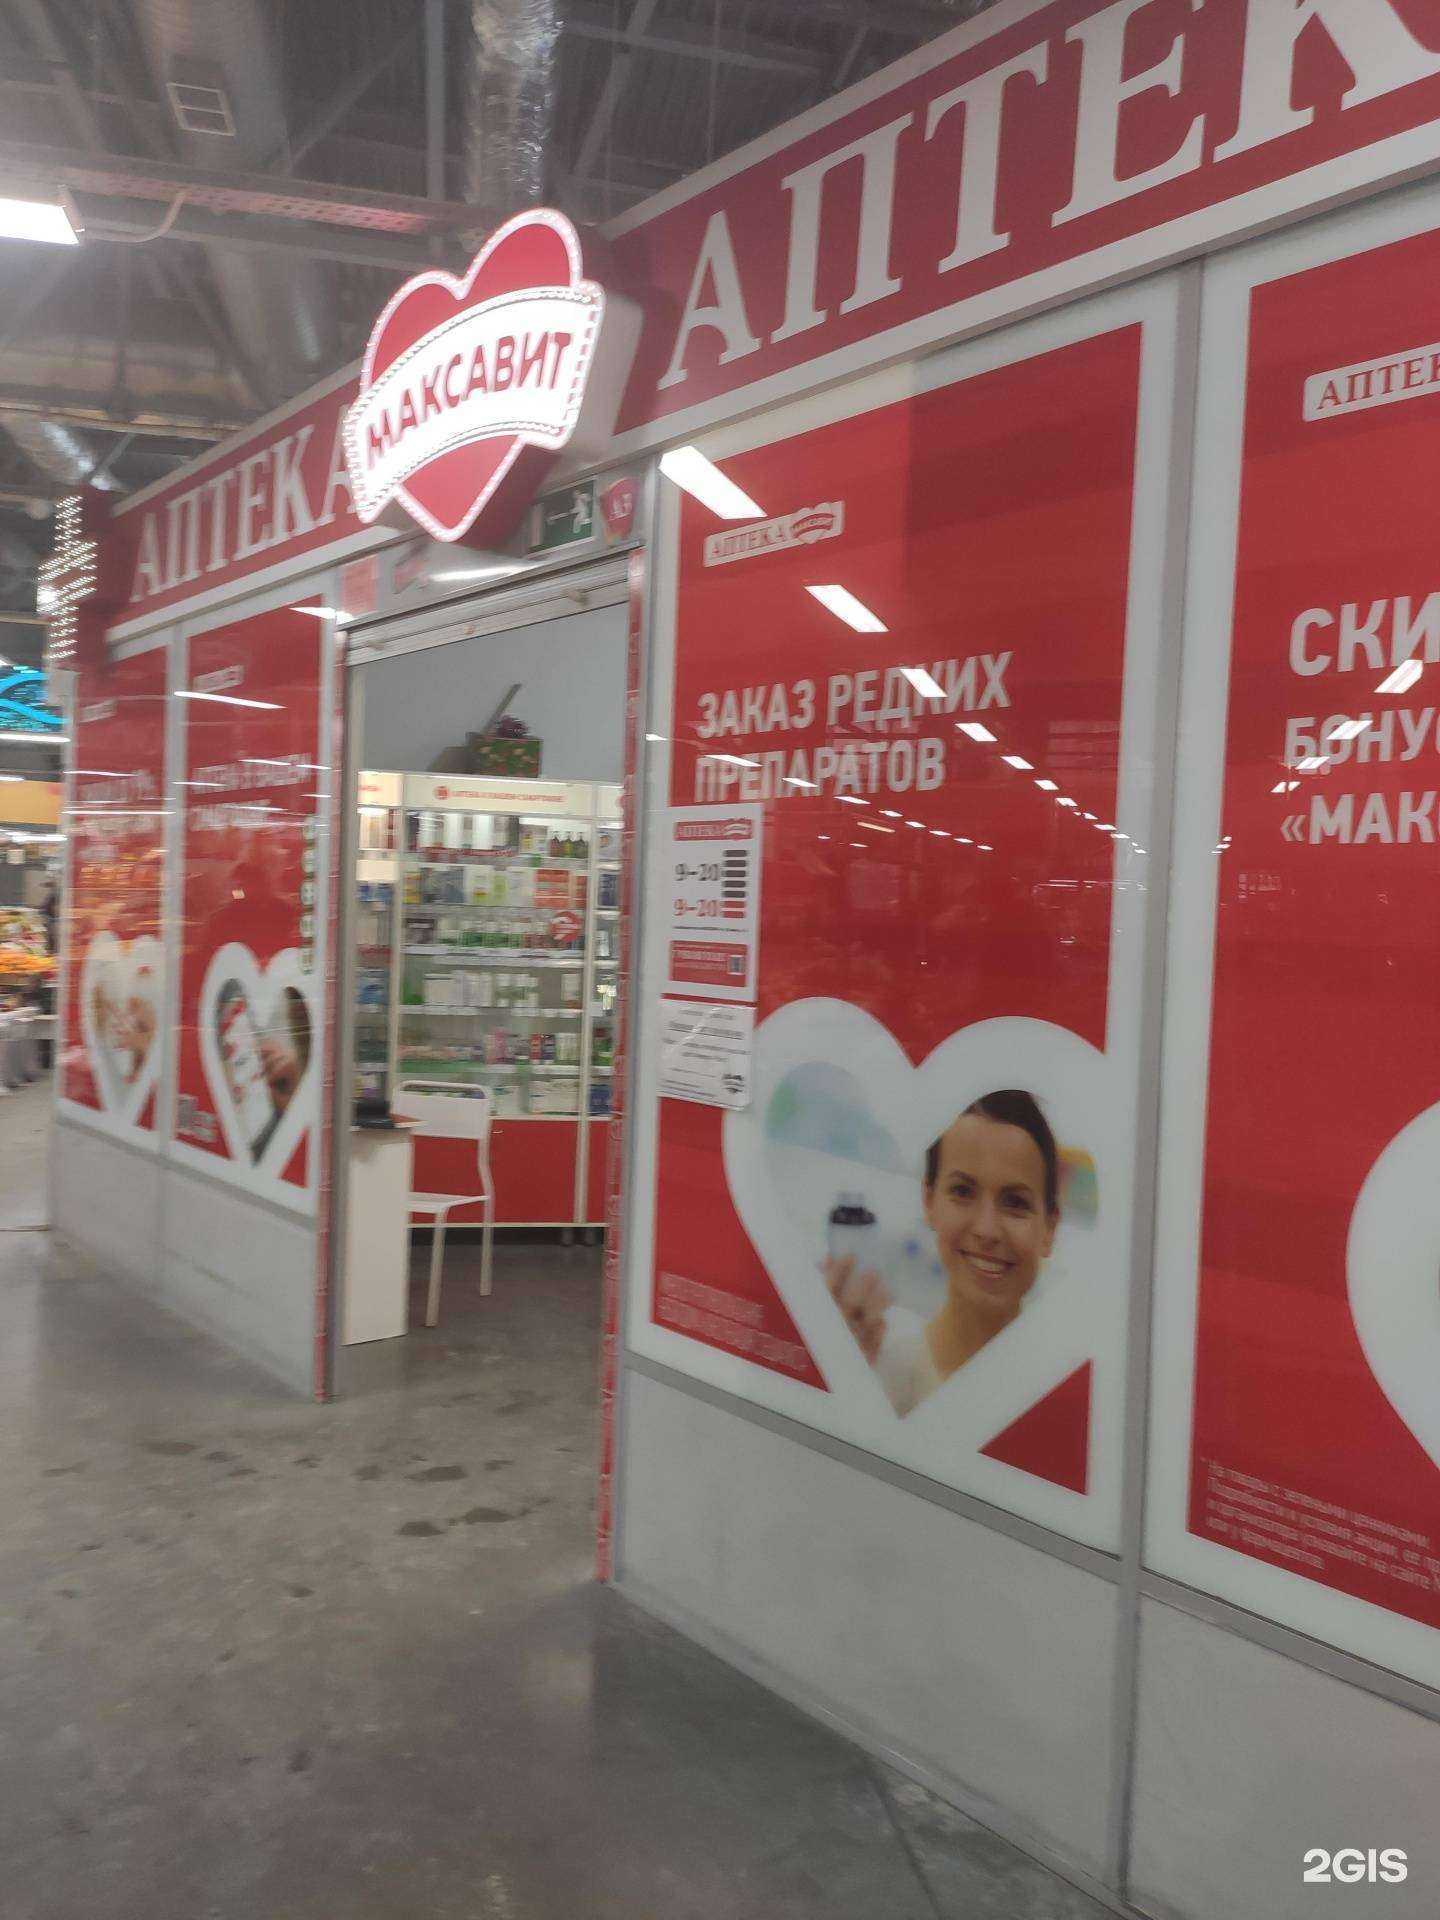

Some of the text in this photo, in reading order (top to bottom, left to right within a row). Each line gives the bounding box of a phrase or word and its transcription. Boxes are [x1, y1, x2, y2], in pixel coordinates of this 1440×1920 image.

[658, 0, 1440, 390] АПТЕК
[366, 331, 576, 471] МАКСАВИТ
[696, 651, 1014, 739] ЗАКАЗ РЕДКИХ
[694, 738, 947, 802] ПРЕПАРАТОВ
[1284, 707, 1440, 768] БОНУ
[1280, 790, 1440, 845] «МАК
